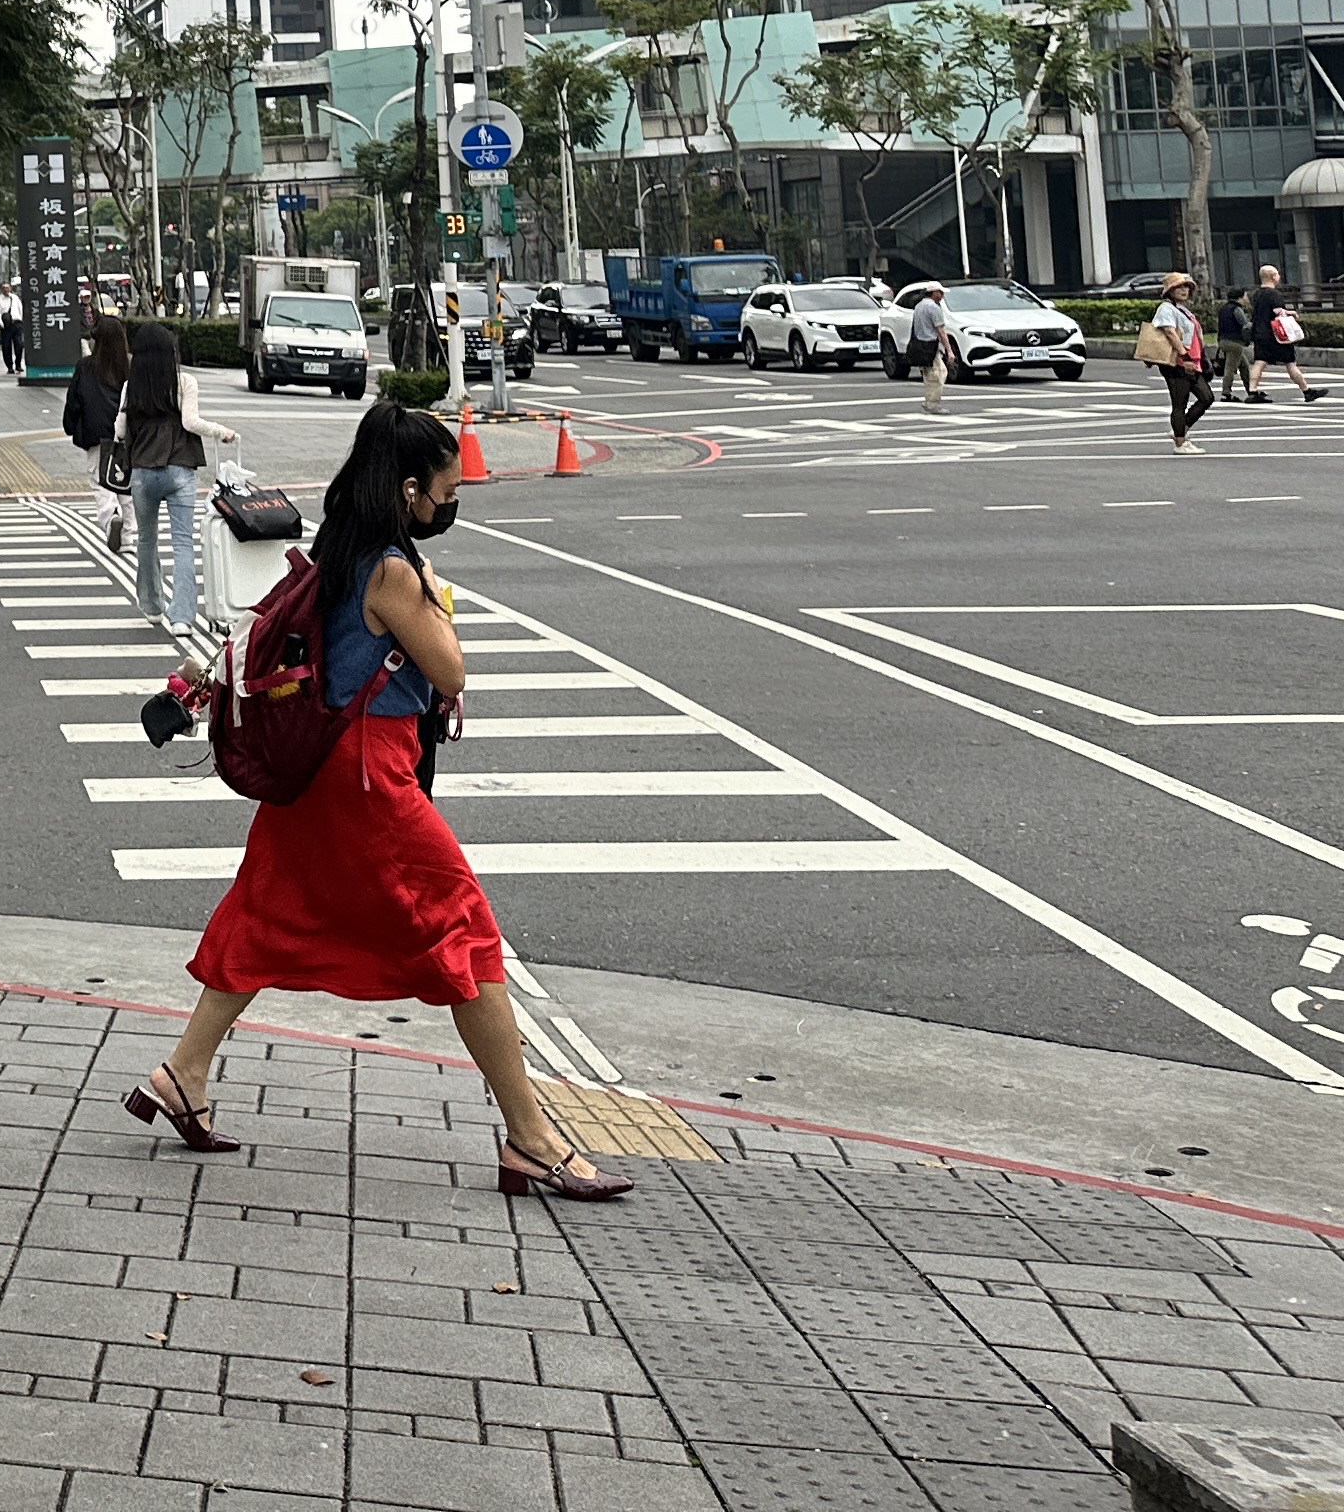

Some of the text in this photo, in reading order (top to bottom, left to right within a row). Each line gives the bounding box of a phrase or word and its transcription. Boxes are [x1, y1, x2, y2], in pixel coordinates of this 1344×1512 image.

[38, 197, 70, 331] 板信商業銀行
[446, 214, 466, 235] 33
[27, 241, 41, 350] BANK OF PANHSIN
